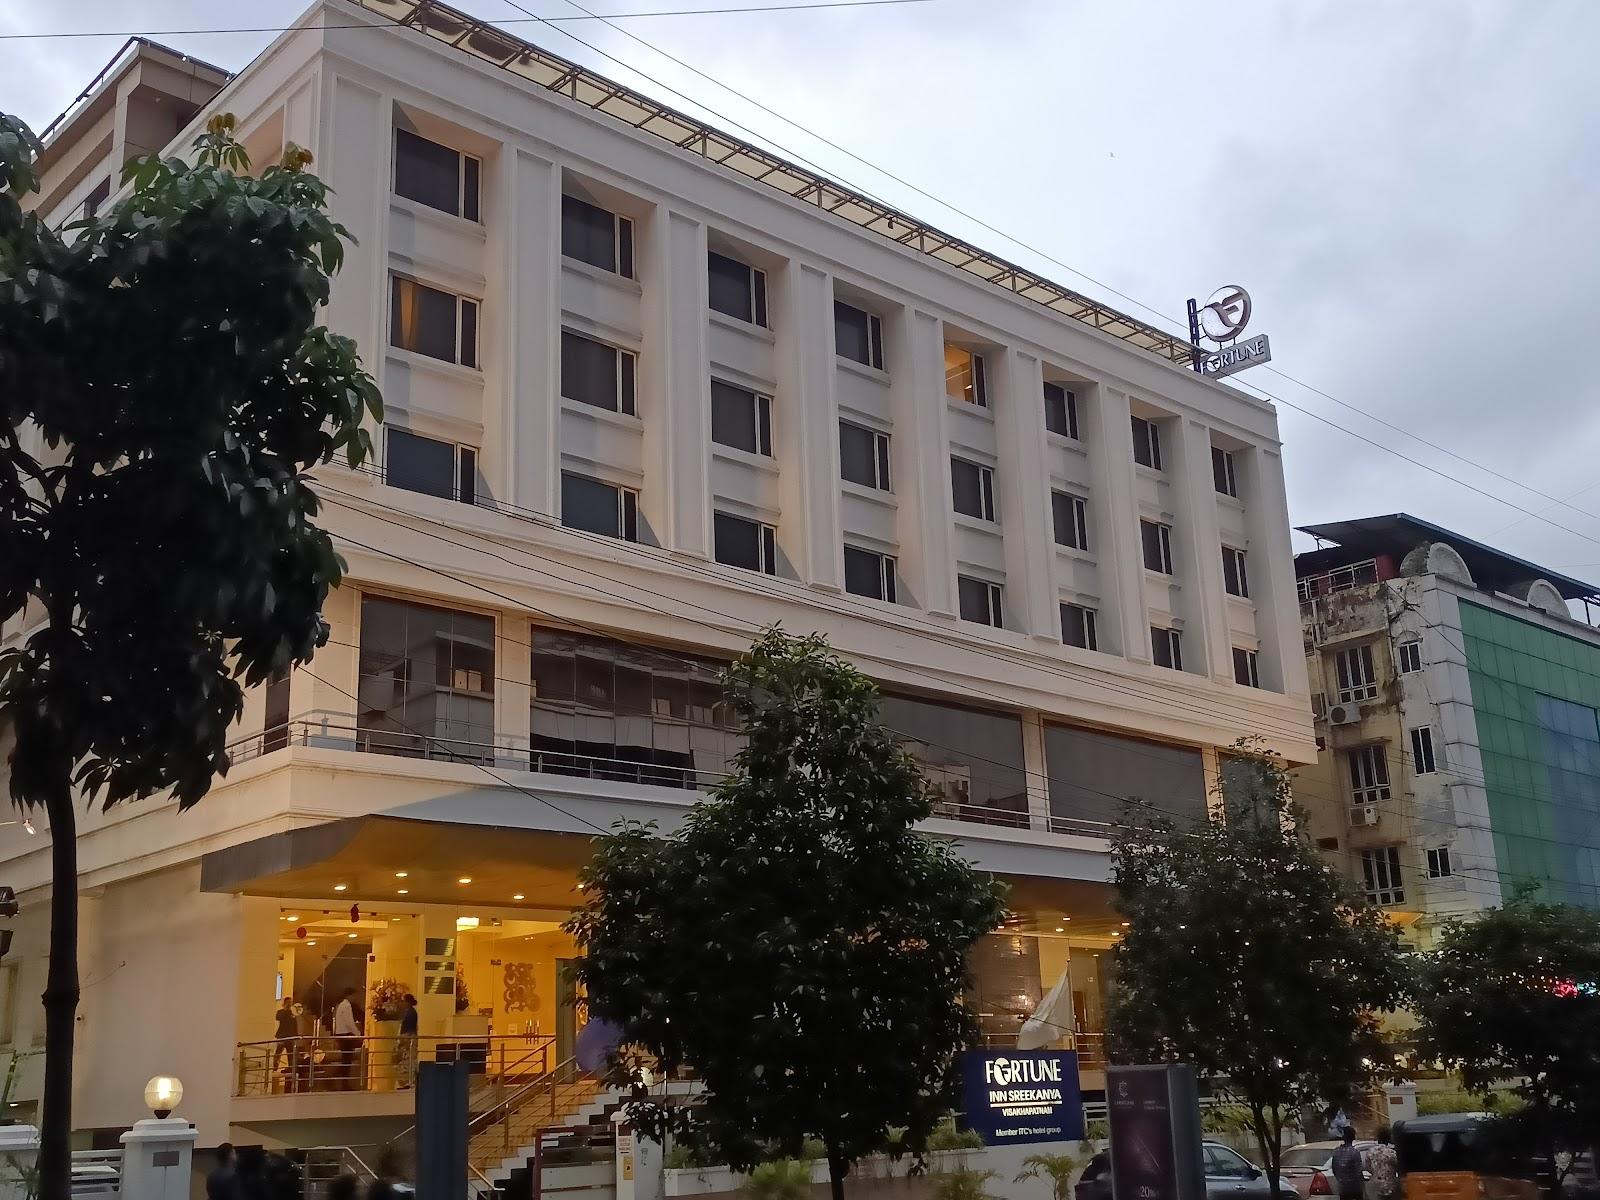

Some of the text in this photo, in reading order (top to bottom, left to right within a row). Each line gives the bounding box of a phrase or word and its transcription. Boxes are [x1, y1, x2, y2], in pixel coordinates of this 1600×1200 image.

[1200, 340, 1264, 375] FORTUNE
[985, 1057, 1062, 1086] FORTUNE
[989, 1088, 1062, 1102] INN SREEKANYA
[995, 1129, 1018, 1137] Member
[1046, 1127, 1061, 1135] group
